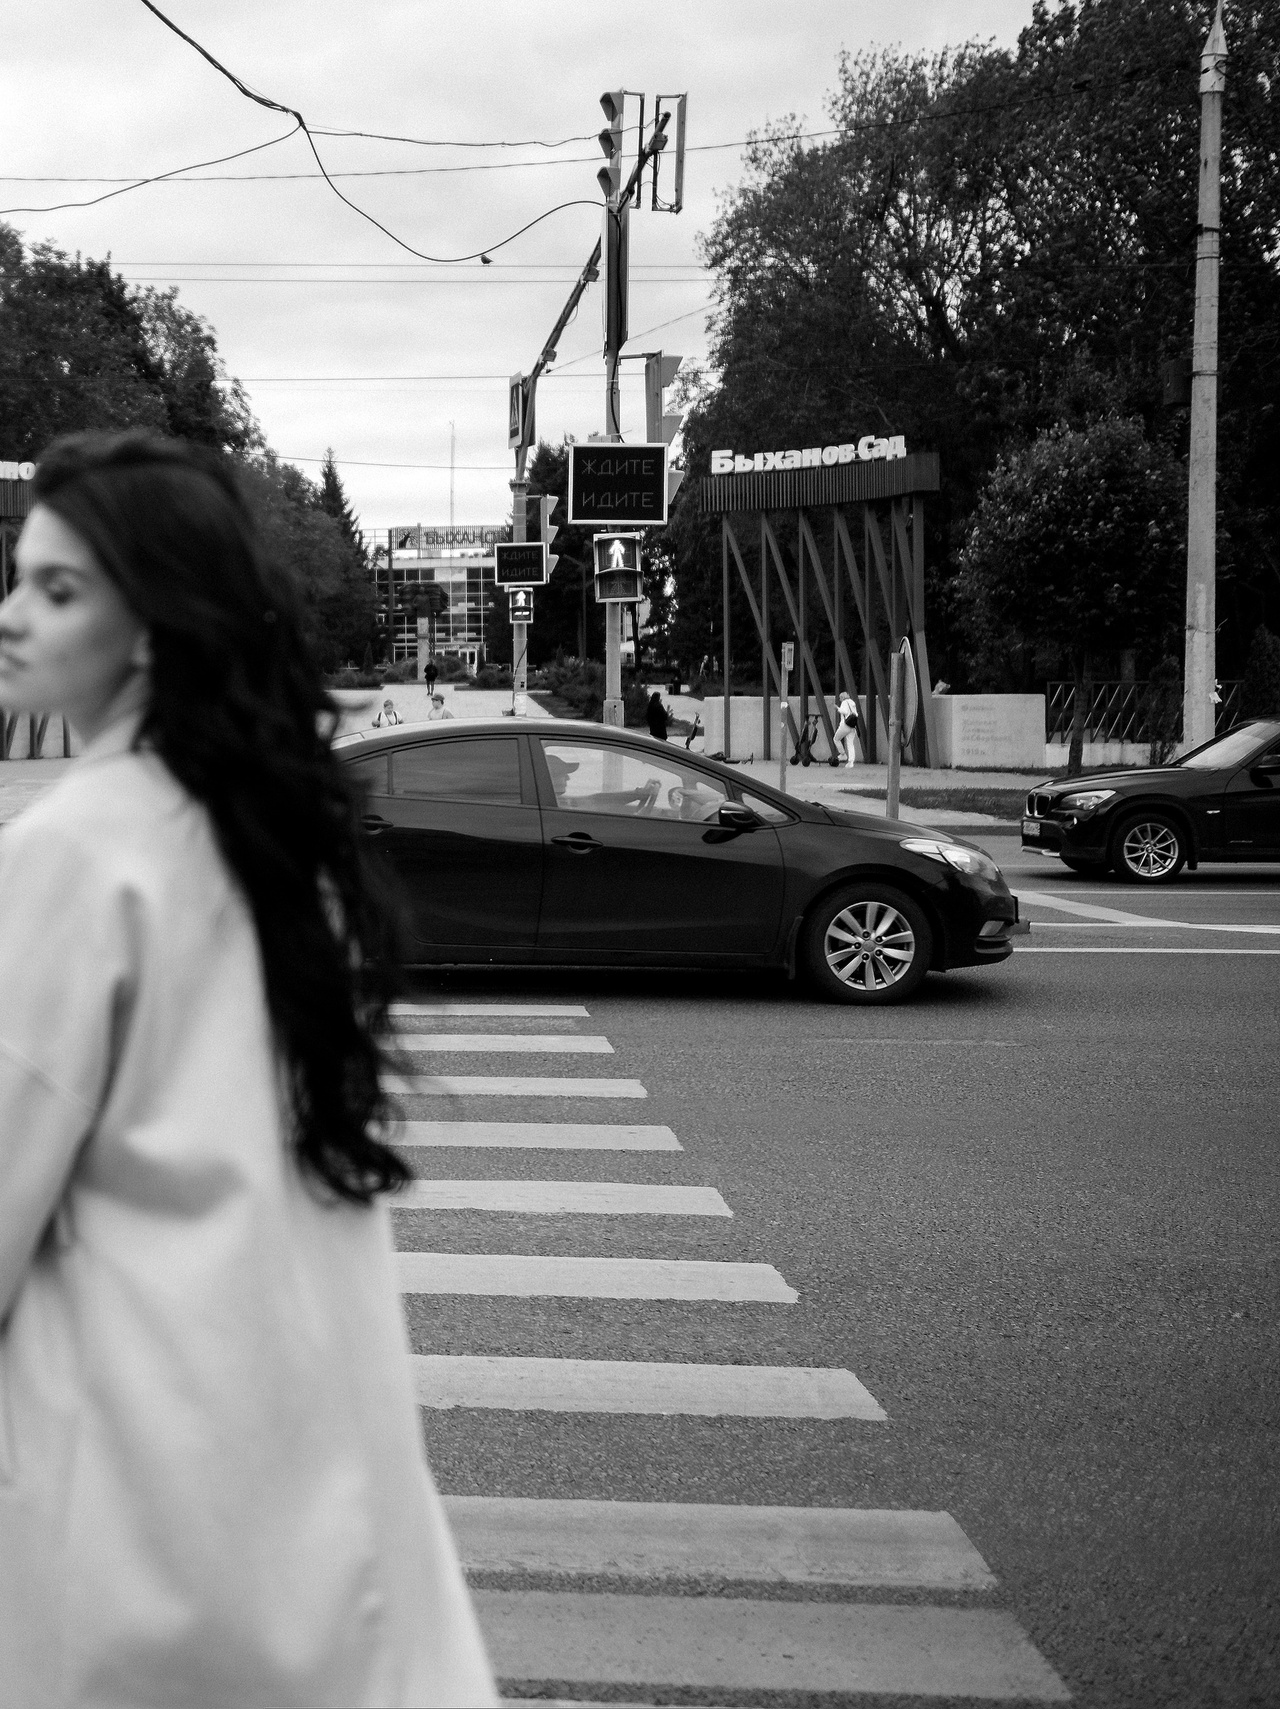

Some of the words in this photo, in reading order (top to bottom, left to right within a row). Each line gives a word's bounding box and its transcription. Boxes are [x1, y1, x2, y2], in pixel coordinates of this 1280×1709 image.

[711, 444, 855, 475] Быханов
[857, 435, 907, 461] Сад
[581, 459, 655, 476] ЖДИТЕ
[582, 492, 654, 509] ИДИТЕ
[501, 550, 539, 562] ЖДИТЕ
[501, 567, 539, 578] ИДИТЕ
